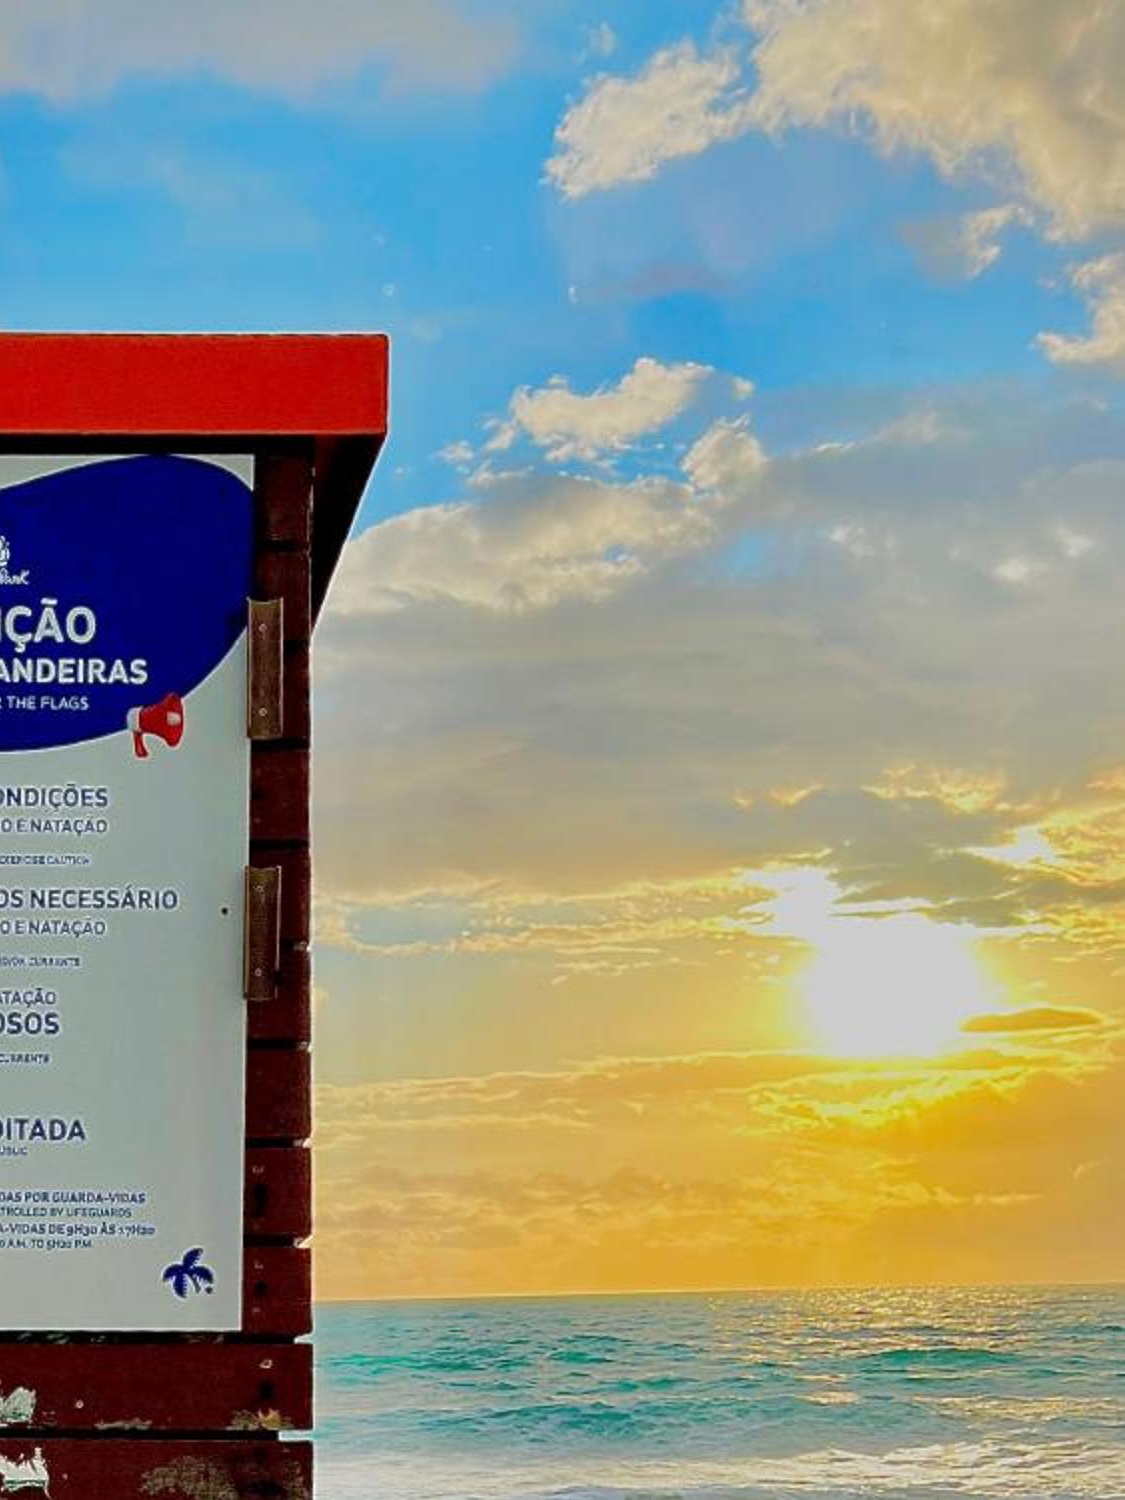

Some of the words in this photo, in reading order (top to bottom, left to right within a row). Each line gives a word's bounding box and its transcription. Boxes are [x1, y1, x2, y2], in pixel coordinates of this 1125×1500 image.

[7, 696, 36, 710] THE
[41, 696, 89, 711] FLAGS
[16, 819, 28, 833] E
[31, 815, 108, 836] NATAÇÃO
[30, 884, 178, 909] NECESSÁRIO
[15, 921, 25, 935] E
[28, 917, 106, 938] NATAÇÃO
[25, 1191, 49, 1203] POR
[52, 1192, 146, 1204] GUARDA-VIDAS
[50, 1207, 64, 1217] BY
[67, 1207, 132, 1218] LIFEGUARDS
[49, 1223, 65, 1235] DE
[31, 1239, 44, 1249] TO
